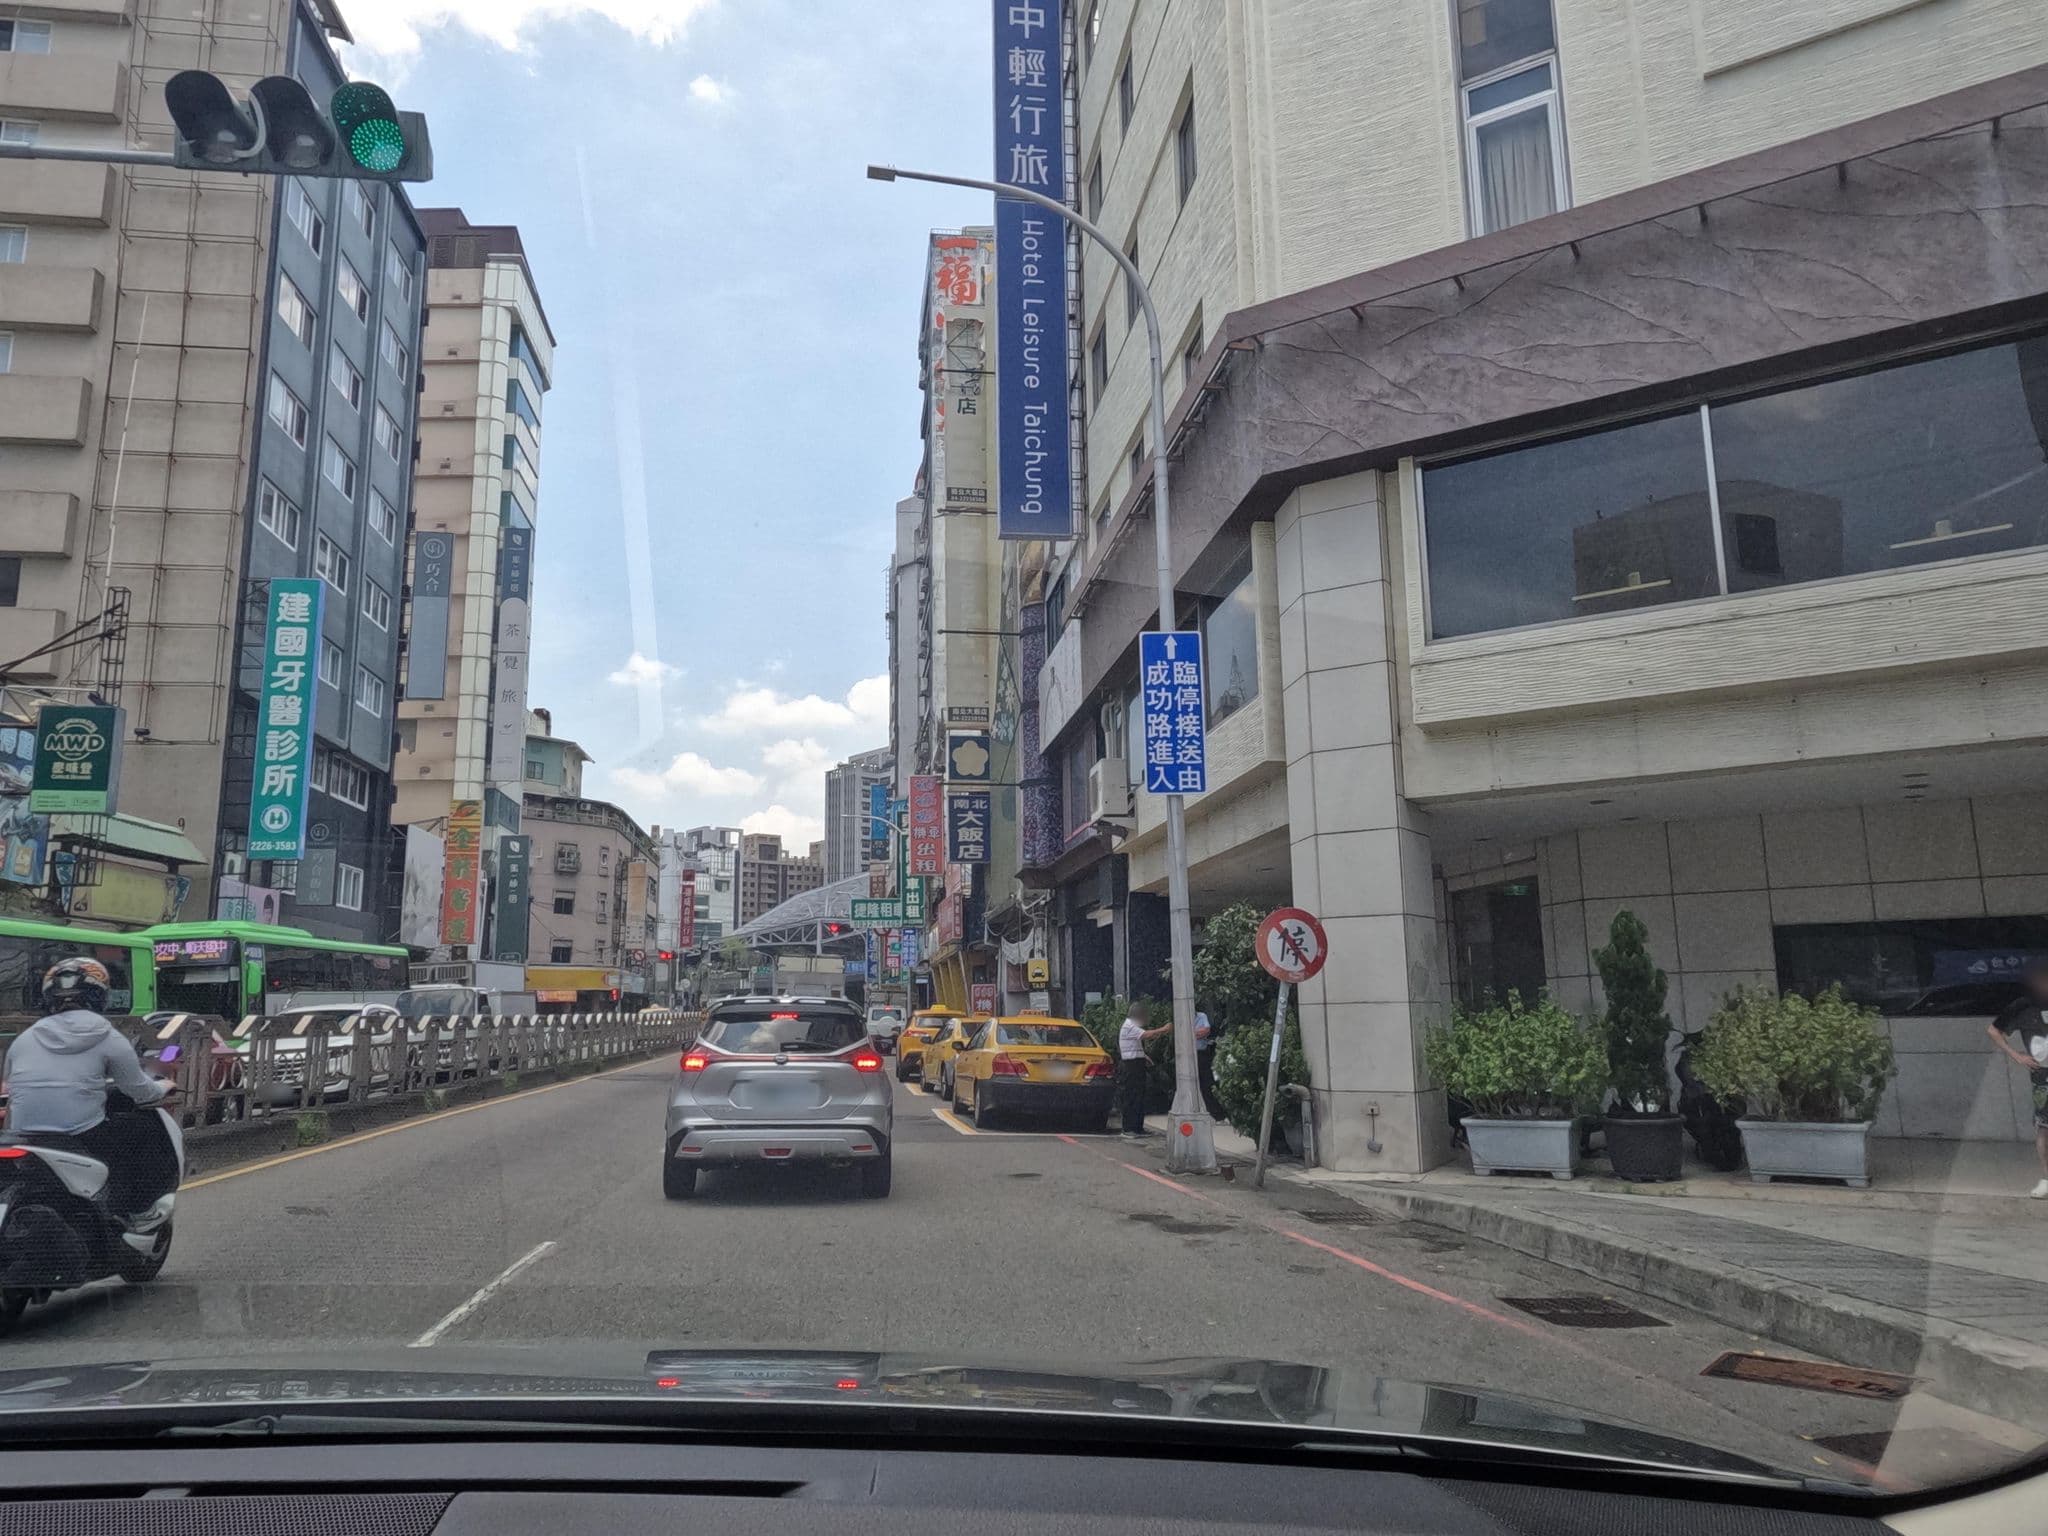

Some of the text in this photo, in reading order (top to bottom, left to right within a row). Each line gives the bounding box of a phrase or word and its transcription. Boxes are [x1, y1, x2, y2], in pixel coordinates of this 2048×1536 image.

[1008, 0, 1049, 185] 中輕行旅
[1021, 219, 1049, 515] Hotel Leisure Taichung
[424, 563, 441, 592] 巧合
[261, 592, 312, 797] 建國牙醫診所
[1146, 660, 1175, 790] 成功路進入
[1173, 661, 1202, 790] 臨停接送由
[44, 733, 105, 752] MWD
[250, 841, 297, 851] 2226-3583
[957, 811, 984, 860] 大飯店
[1278, 926, 1309, 967] 停
